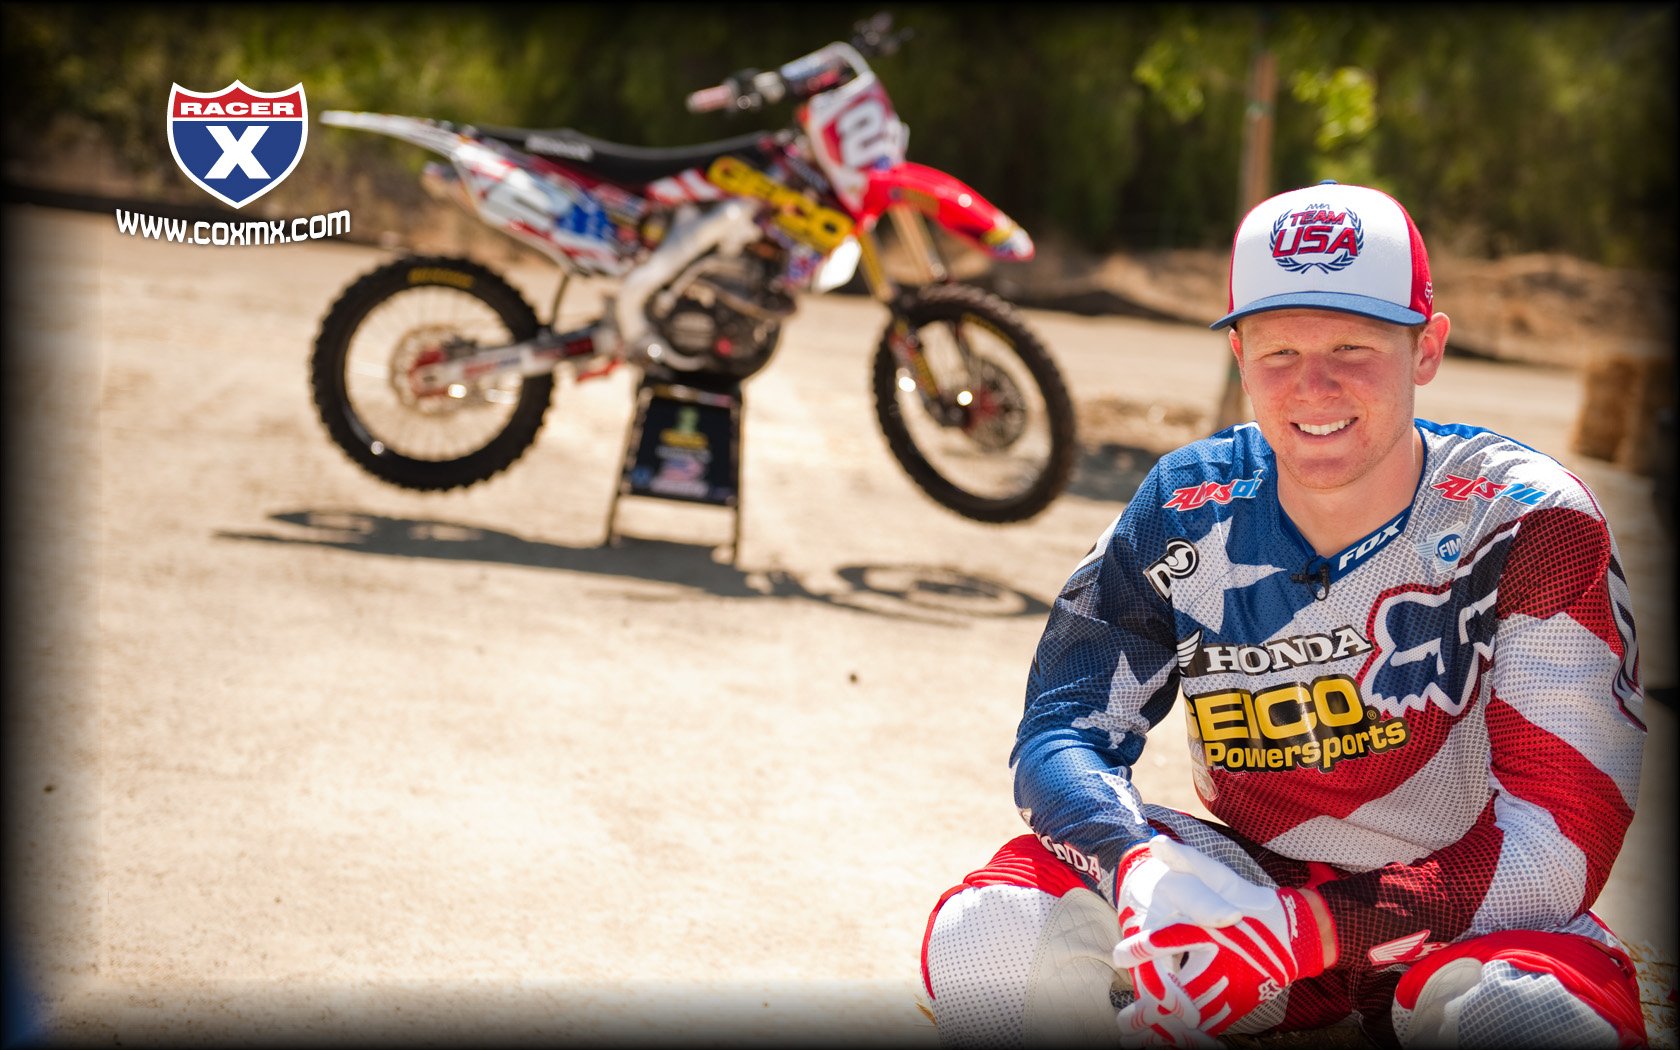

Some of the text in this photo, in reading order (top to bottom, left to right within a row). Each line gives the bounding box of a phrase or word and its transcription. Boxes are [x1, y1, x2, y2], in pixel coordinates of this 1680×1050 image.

[1290, 210, 1346, 227] TEAM
[1272, 225, 1358, 258] USA
[1162, 470, 1263, 511] AMSOI
[1339, 515, 1404, 571] FOX
[1439, 538, 1462, 558] FIM
[1203, 628, 1374, 674] HONDA
[1204, 721, 1406, 768] Powersports
[1038, 834, 1102, 882] ONDA
